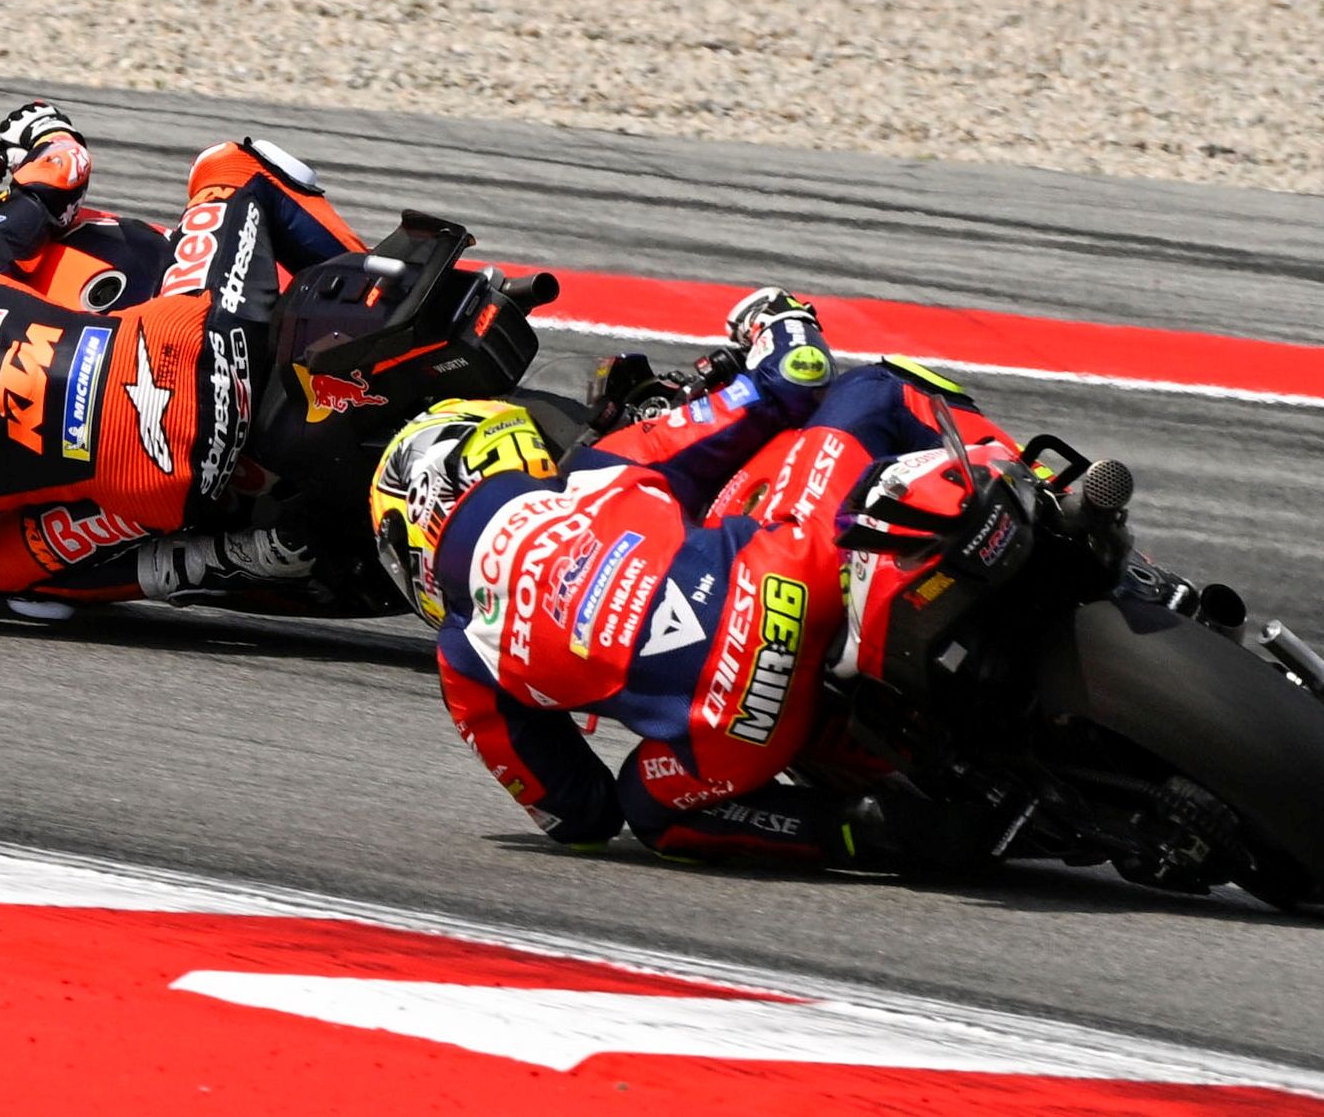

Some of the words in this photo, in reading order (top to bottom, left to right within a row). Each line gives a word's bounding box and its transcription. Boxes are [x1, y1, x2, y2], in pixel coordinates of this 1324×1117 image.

[162, 202, 227, 298] Red
[220, 201, 261, 314] alpinestars
[72, 336, 101, 424] MICHELIN
[199, 330, 227, 496] alpinestars
[962, 504, 1004, 557] HONDA
[583, 540, 630, 619] MICHELIN
[608, 559, 647, 613] HEART.
[599, 612, 618, 647] One
[702, 562, 759, 730] DAINESE
